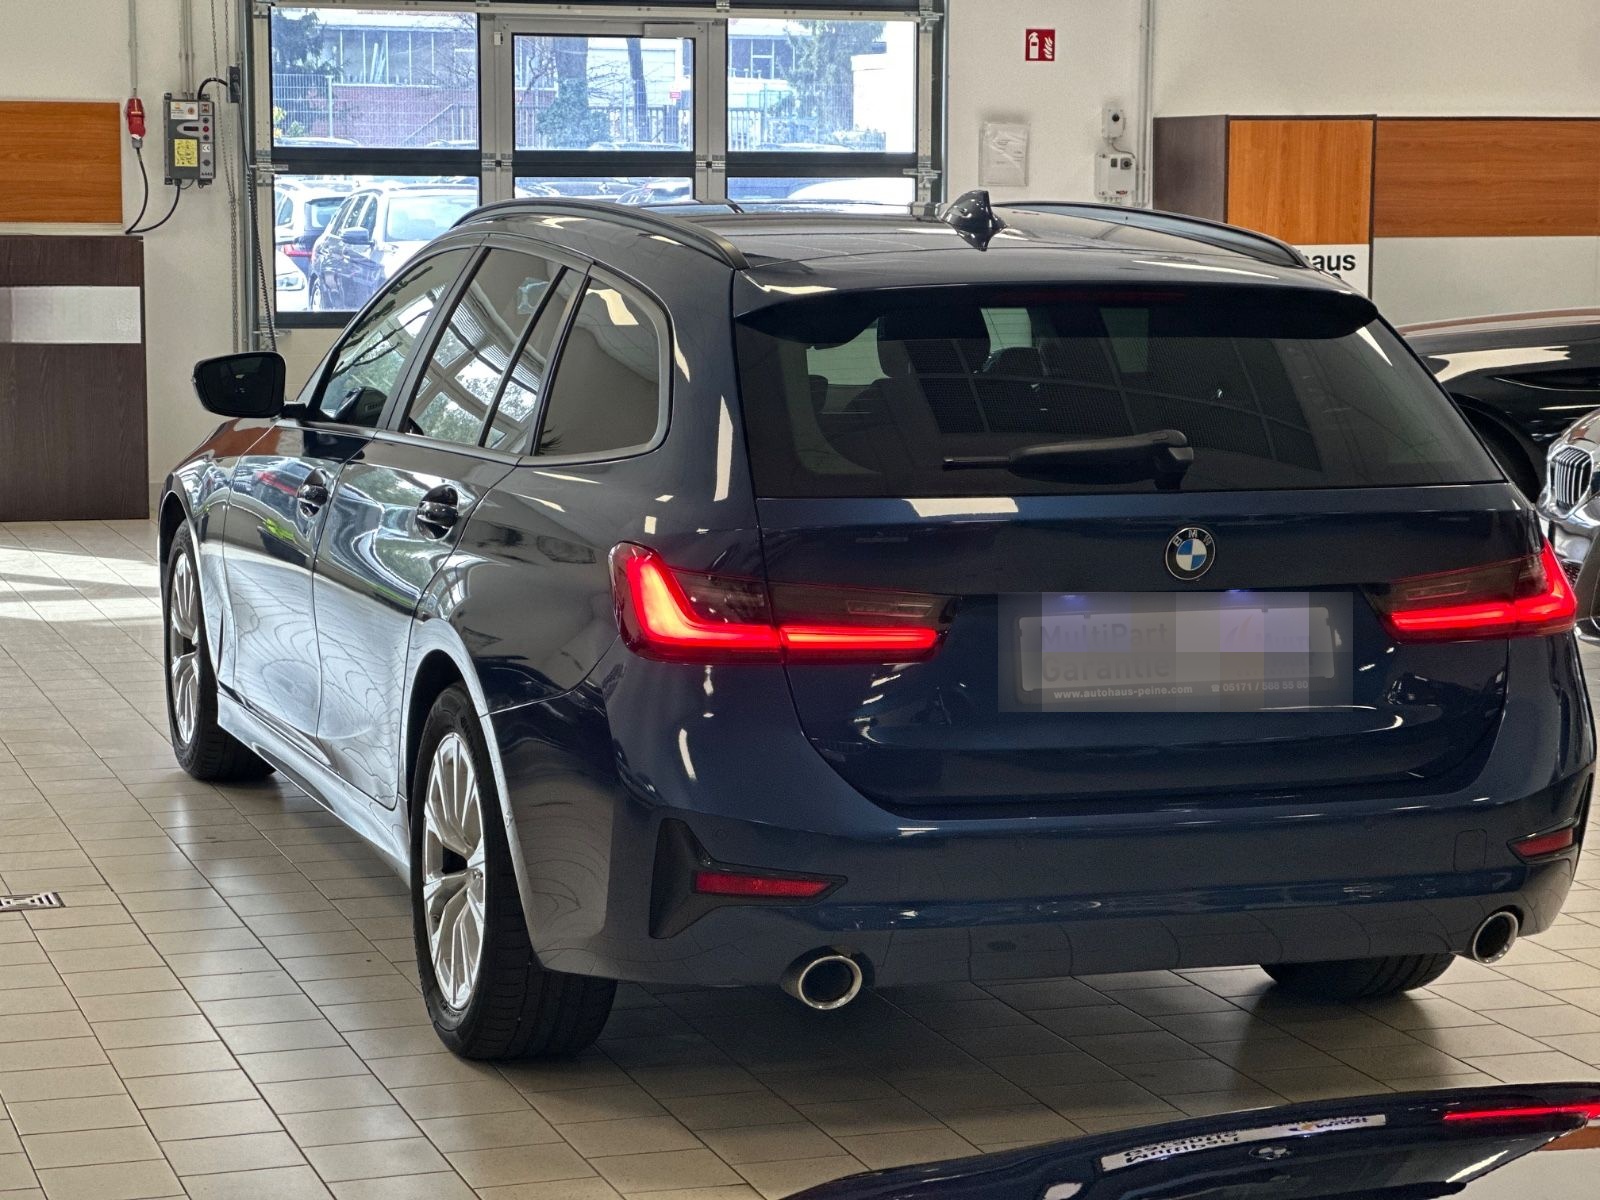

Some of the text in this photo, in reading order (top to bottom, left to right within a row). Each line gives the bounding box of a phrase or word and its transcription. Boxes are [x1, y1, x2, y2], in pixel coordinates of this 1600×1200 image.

[1305, 254, 1356, 271] aus
[1042, 655, 1172, 682] Garantie
[1053, 685, 1193, 699] www.autohaus-peine.com
